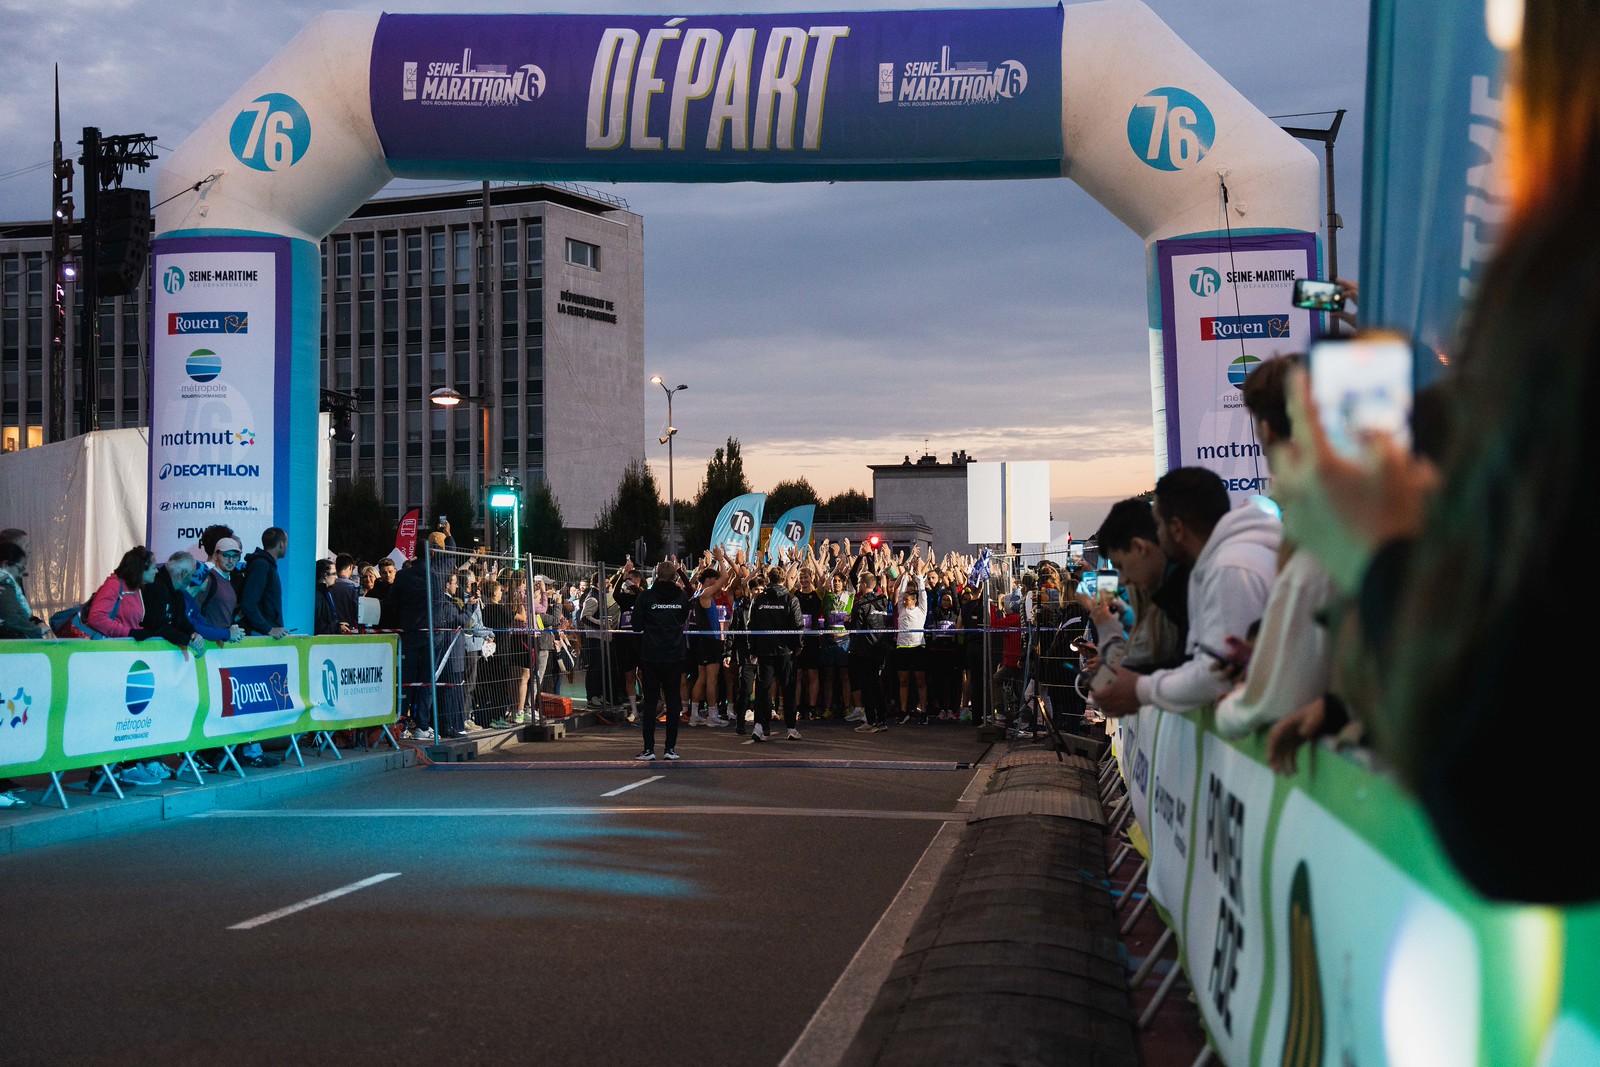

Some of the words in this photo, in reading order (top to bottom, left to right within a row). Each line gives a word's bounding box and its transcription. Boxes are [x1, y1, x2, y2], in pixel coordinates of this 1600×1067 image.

[427, 62, 459, 77] SEINE
[904, 61, 939, 76] SEINE
[421, 77, 518, 101] MARATHON
[514, 67, 540, 101] 76
[585, 17, 850, 150] DÉPART
[899, 76, 999, 100] MARATHON
[999, 64, 1021, 96] 76
[243, 101, 294, 171] 76
[1136, 95, 1199, 170] 76
[165, 268, 181, 293] 76
[189, 270, 258, 282] SEINE-MARITIME
[1191, 269, 1214, 297] 76
[1226, 269, 1296, 283] SEINE-MARITIME
[558, 303, 566, 314] LA
[567, 305, 617, 325] SEINE-MARITIME
[606, 301, 614, 311] DE
[175, 316, 220, 332] Rouen
[1211, 321, 1264, 337] Rouen
[181, 383, 227, 393] métropole
[161, 430, 234, 447] matmut
[1197, 442, 1266, 460] matm
[173, 465, 260, 477] DECATHLON
[172, 501, 216, 510] HYUNDAI
[734, 511, 751, 535] 76
[788, 522, 802, 542] 76
[341, 666, 383, 686] SEINE-MARITIME
[229, 676, 272, 710] Rouen
[115, 716, 152, 732] métropole
